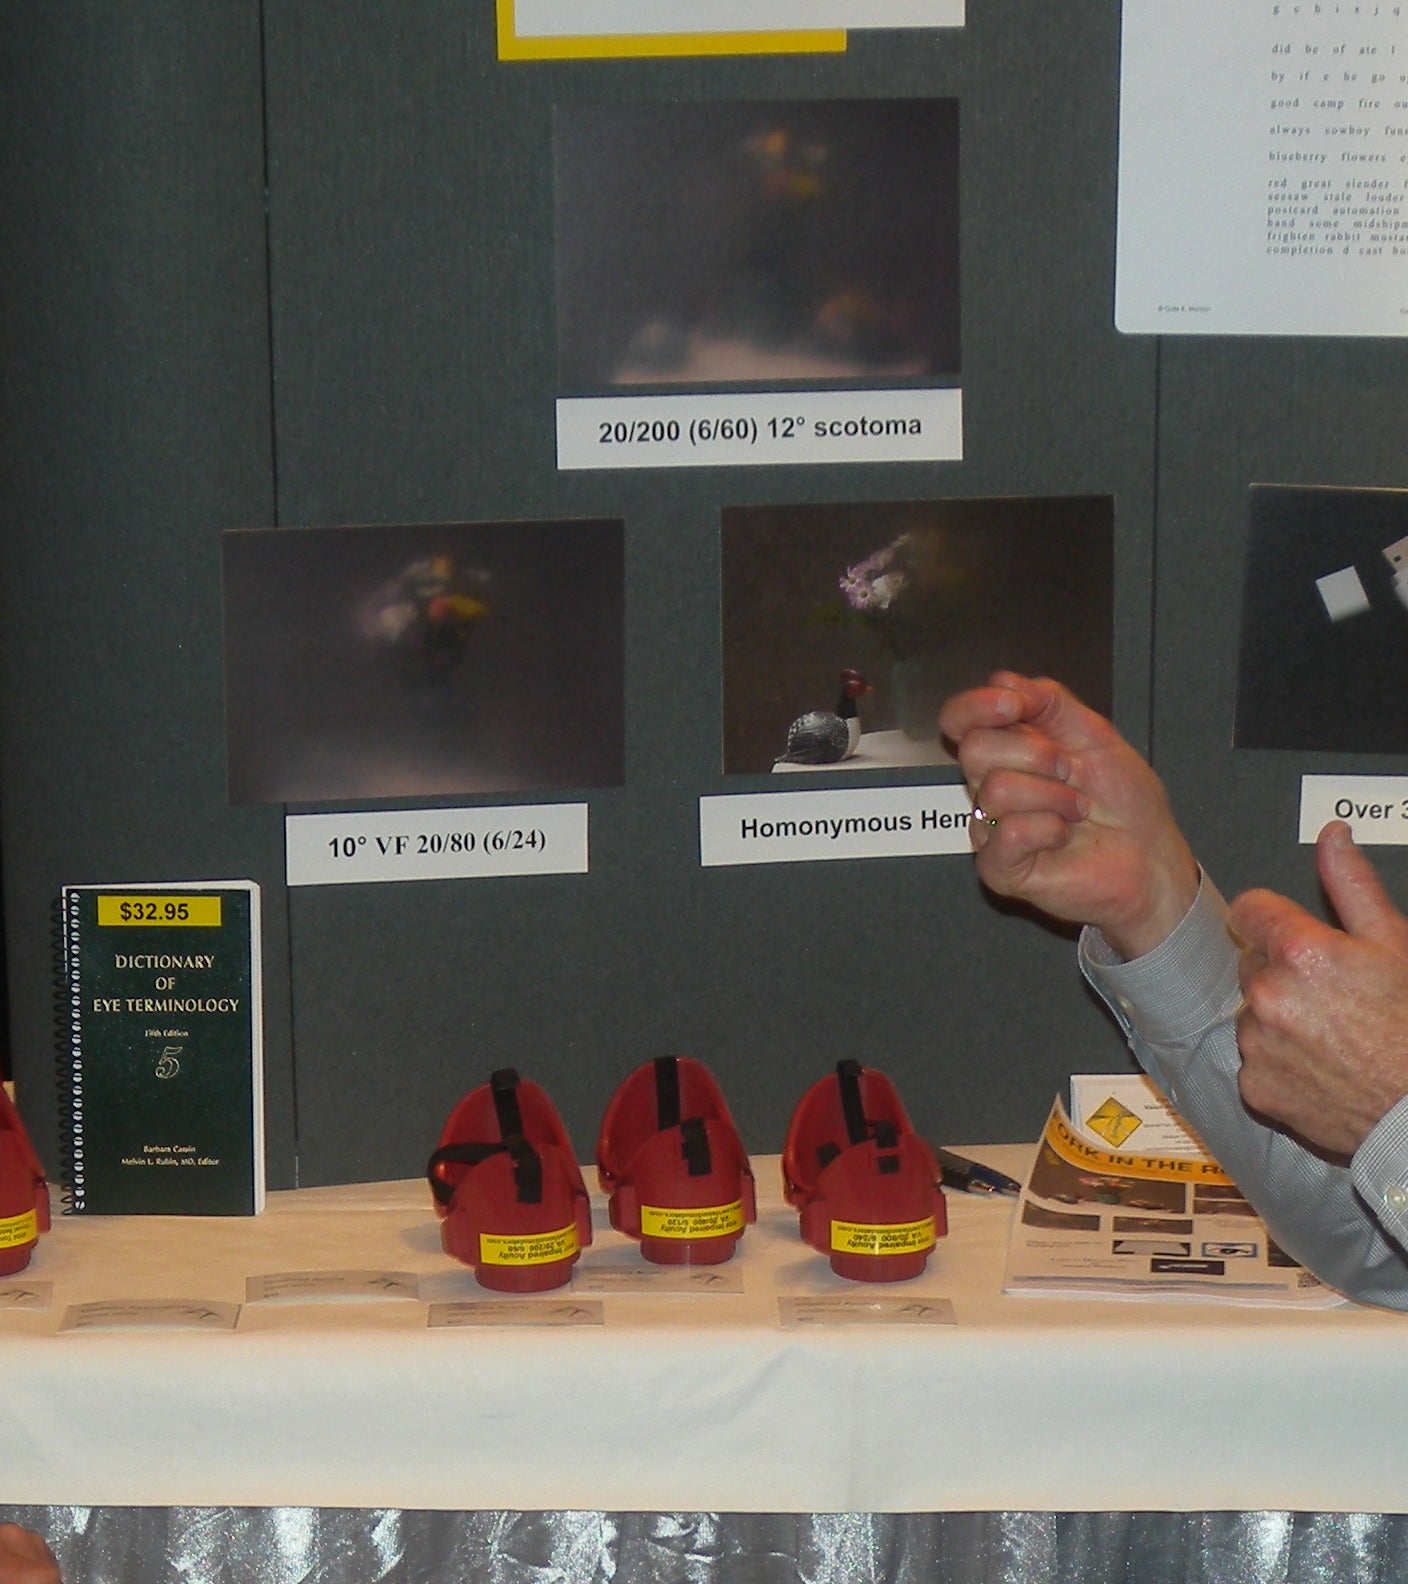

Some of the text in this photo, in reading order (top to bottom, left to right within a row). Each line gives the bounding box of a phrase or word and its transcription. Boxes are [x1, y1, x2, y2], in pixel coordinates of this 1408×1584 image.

[599, 416, 921, 446] 20/200 (6/60) 12° scotoma
[1333, 798, 1394, 820] Over
[741, 815, 912, 840] Homonymous
[329, 829, 546, 858] 10° VF 20/80 (6/24)
[119, 901, 189, 922] $32.95
[114, 954, 215, 969] DICTIONARY
[155, 976, 176, 991] OF
[93, 998, 239, 1013] EYE TERMINOLOGY
[163, 1029, 189, 1037] Edition
[155, 1046, 183, 1079] 5
[1109, 1155, 1133, 1166] IN
[1143, 1158, 1192, 1173] THE
